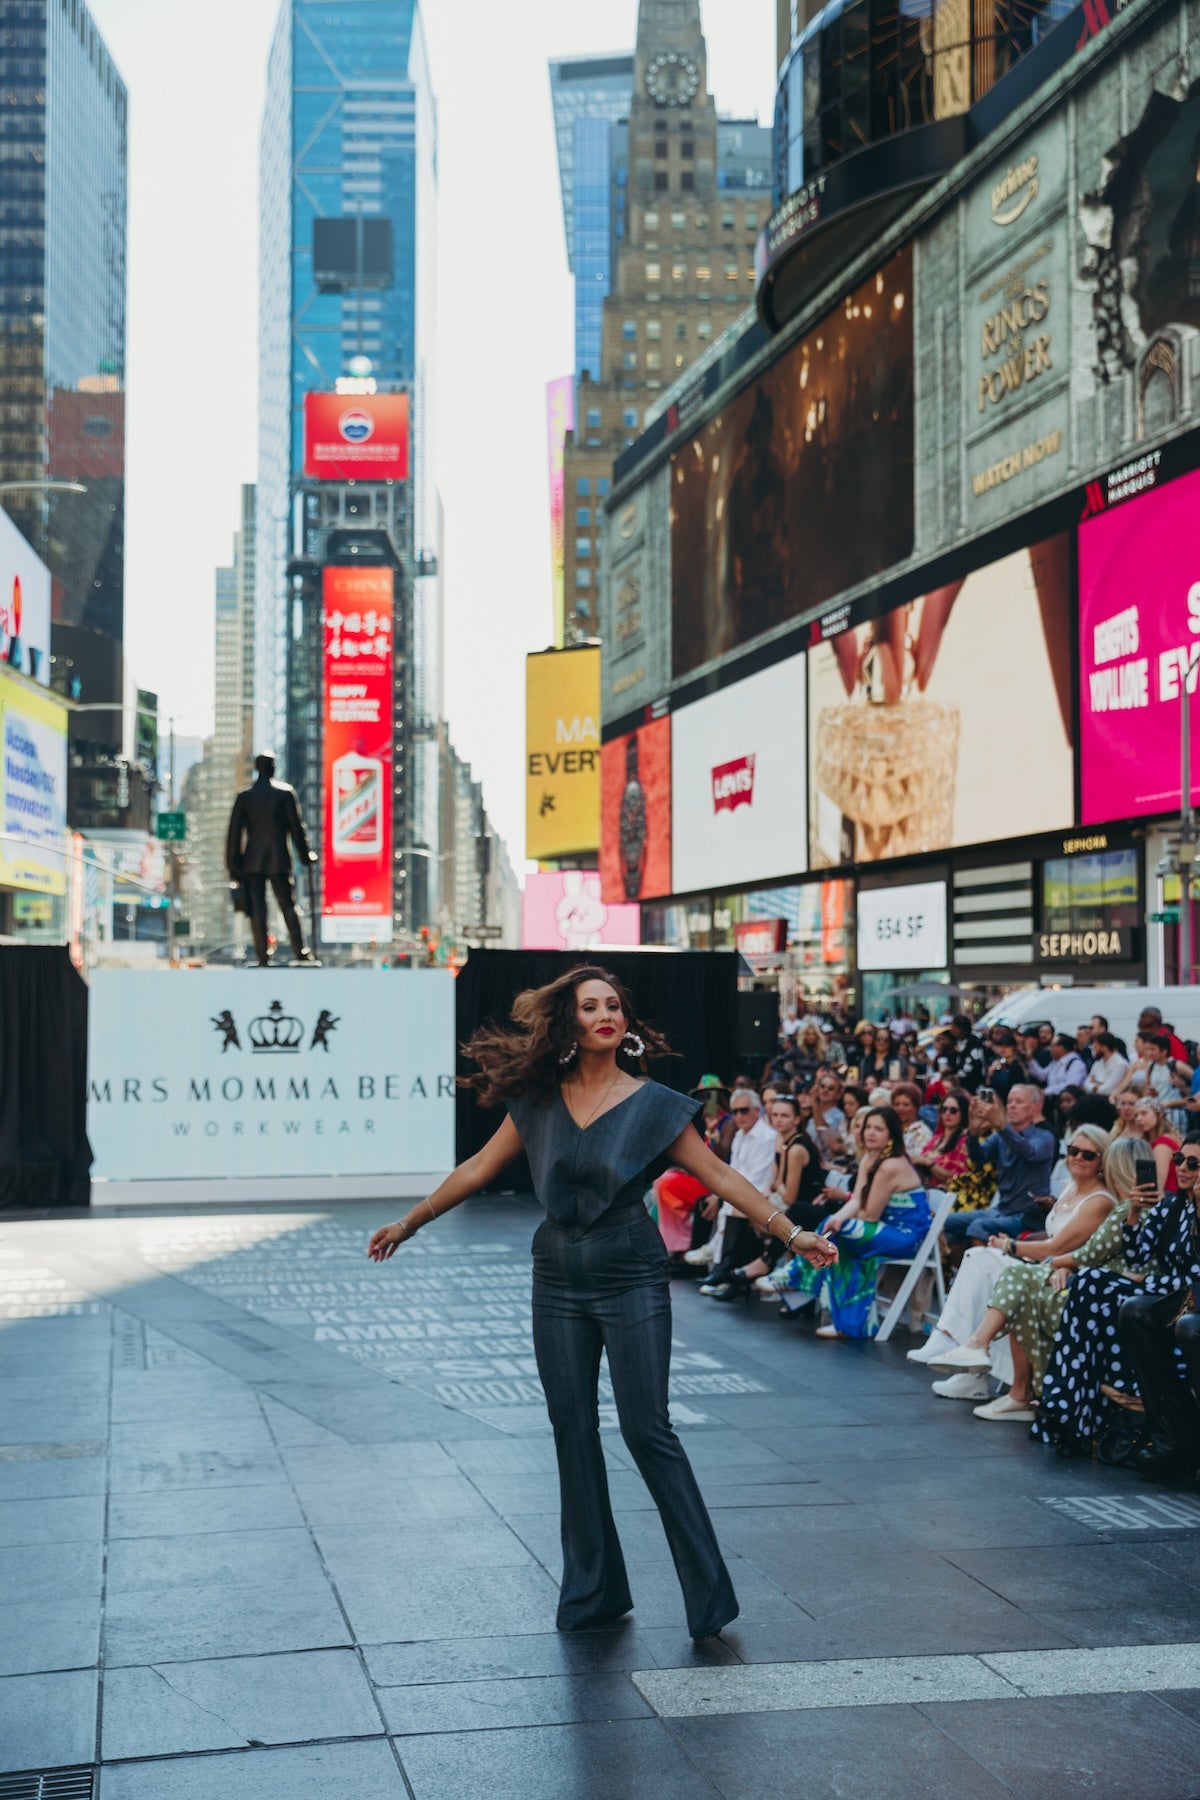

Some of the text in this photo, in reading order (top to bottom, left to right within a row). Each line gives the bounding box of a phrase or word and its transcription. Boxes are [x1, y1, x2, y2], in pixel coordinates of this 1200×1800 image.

[981, 278, 1049, 360] RINGS
[977, 332, 1053, 414] POWER
[972, 429, 1063, 497] WATCH NOW
[1107, 450, 1161, 489] MARRIOTT
[1107, 469, 1155, 504] MARQUIS
[1063, 834, 1108, 854] SEPHORA
[907, 916, 924, 938] SF
[1040, 930, 1121, 957] SEPHORA
[86, 1074, 456, 1102] MRS MOMMA BEAR
[171, 1118, 376, 1138] WORKWEAR
[309, 1306, 443, 1324] KERR
[314, 1319, 534, 1342] AMBASS
[434, 1381, 547, 1402] BROA
[1063, 1494, 1200, 1529] BEA
